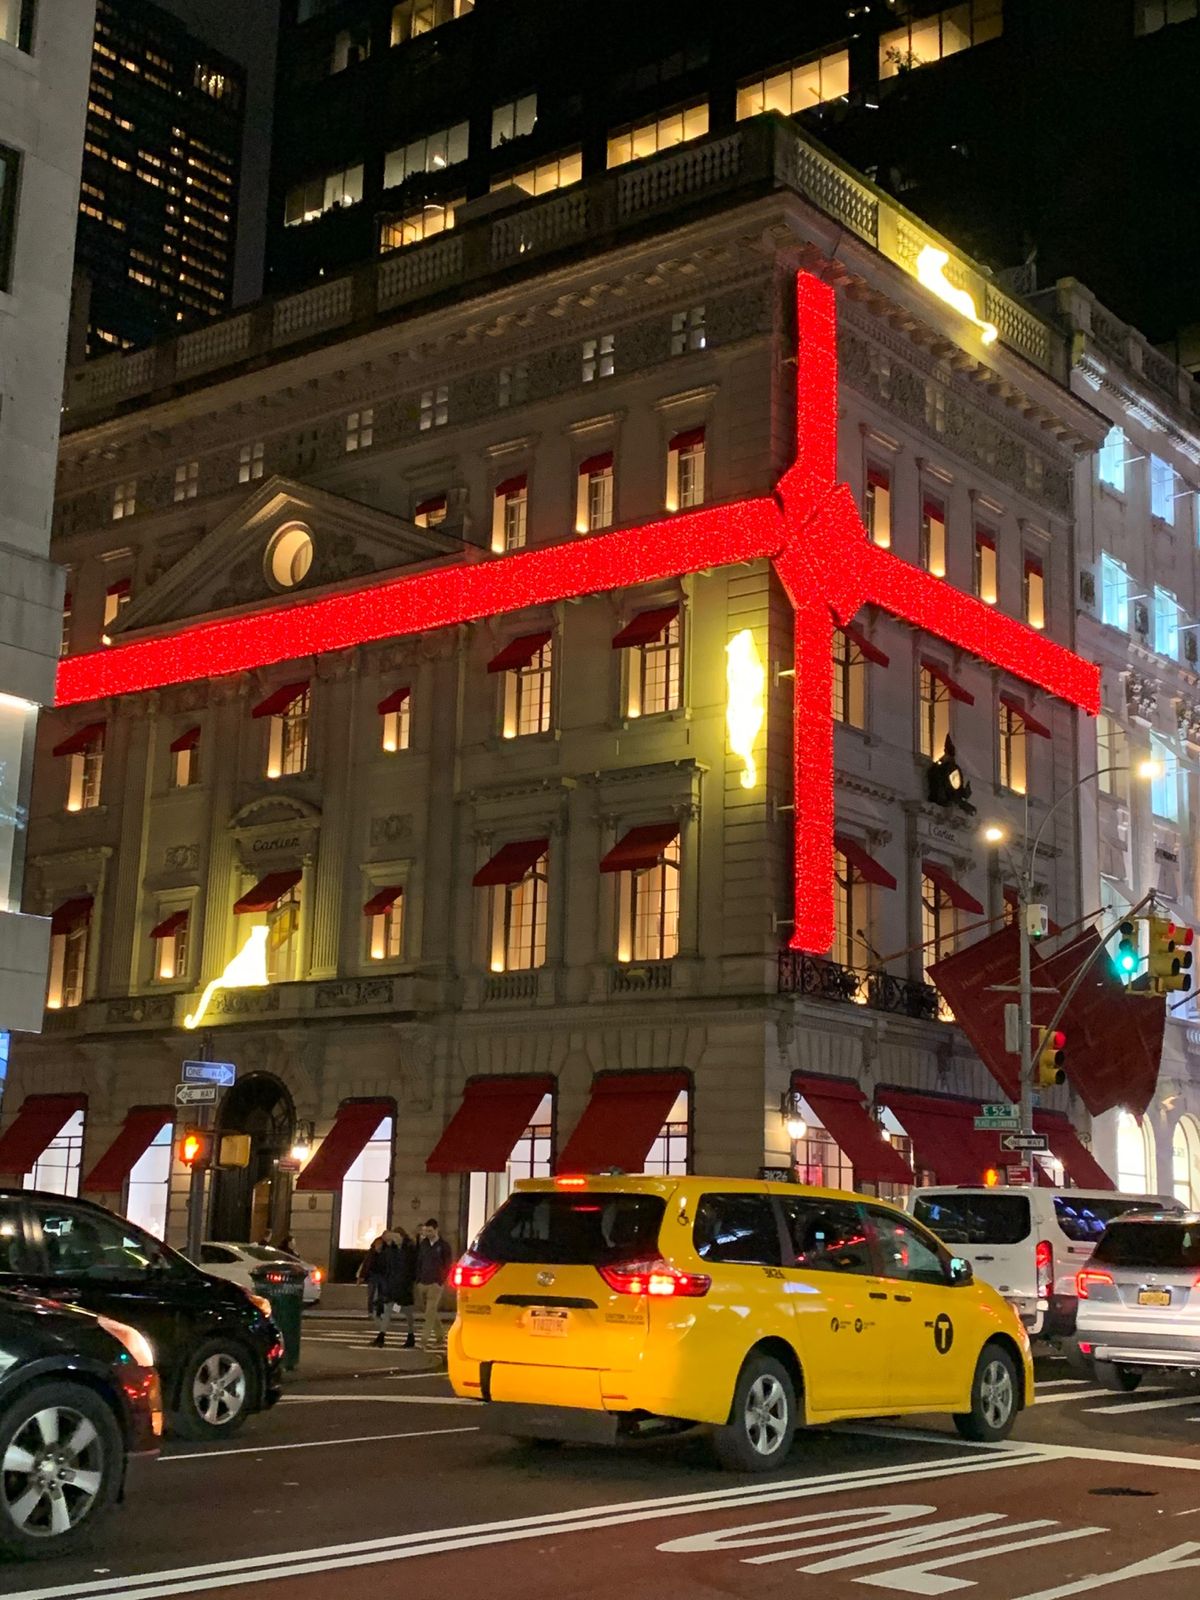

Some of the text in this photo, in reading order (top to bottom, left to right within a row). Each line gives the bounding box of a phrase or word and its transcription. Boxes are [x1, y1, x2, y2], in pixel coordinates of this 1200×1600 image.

[252, 837, 301, 852] Cartier
[187, 1067, 228, 1078] ONE WAY
[180, 1089, 214, 1100] ONE WAY
[1027, 1138, 1041, 1146] WAY
